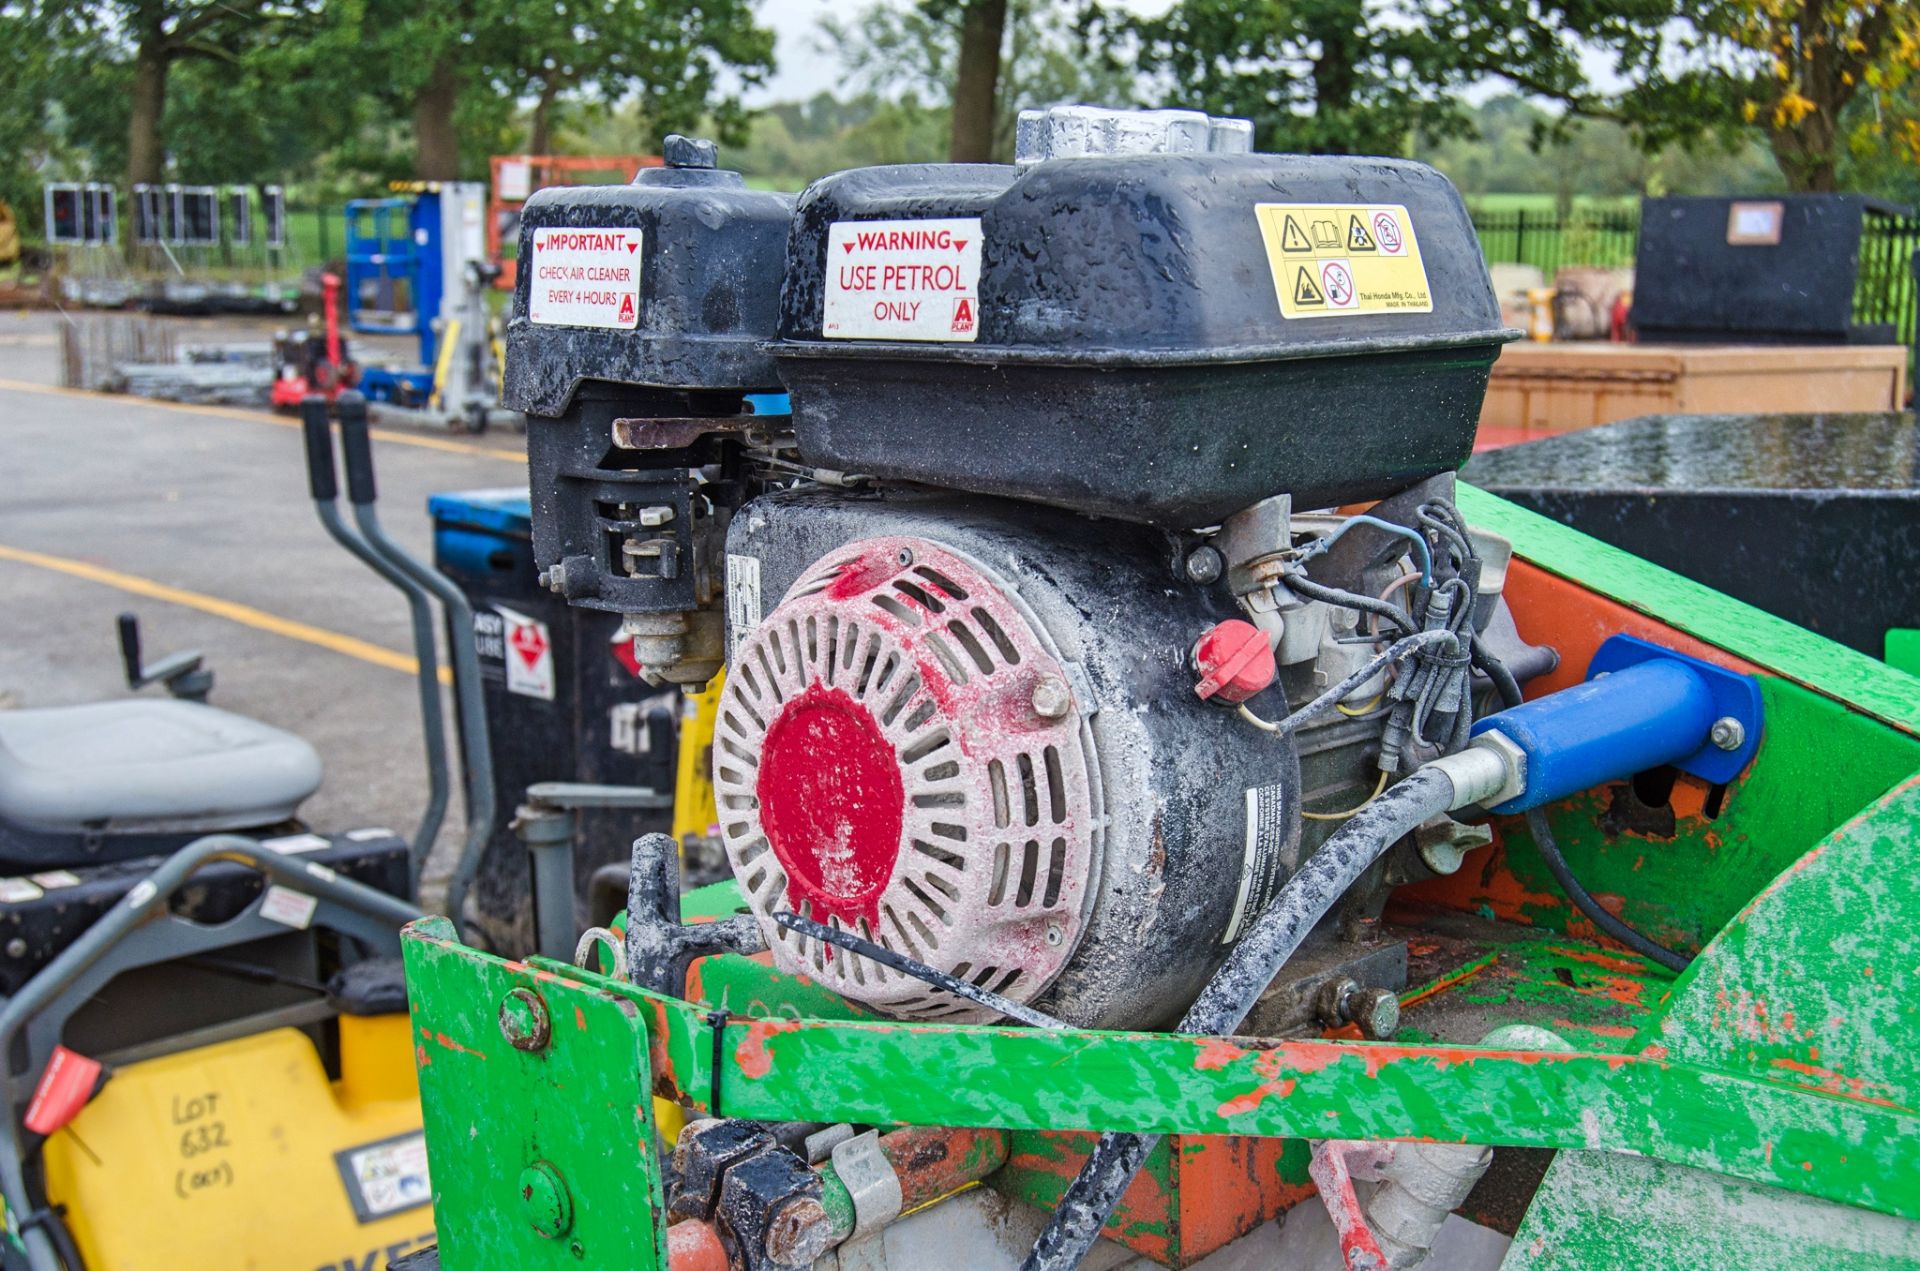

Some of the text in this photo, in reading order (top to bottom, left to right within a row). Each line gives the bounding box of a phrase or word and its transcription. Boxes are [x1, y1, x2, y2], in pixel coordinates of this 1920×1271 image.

[546, 233, 626, 251] IMPORTANT
[857, 230, 951, 251] WARNING
[539, 266, 631, 282] CHECK AIR CLEANER
[840, 265, 967, 291] USE PETROL
[548, 290, 617, 306] EVERY 4 HOURS
[620, 294, 634, 314] A
[1359, 292, 1372, 300] Thai
[1373, 292, 1391, 300] Honda
[874, 301, 921, 321] ONLY
[954, 299, 972, 322] A
[951, 322, 974, 332] PLANT
[1264, 786, 1269, 795] CE
[1257, 836, 1263, 847] LA
[1254, 847, 1263, 874] NORME
[172, 1093, 221, 1126] LOT
[180, 1121, 233, 1158] 632
